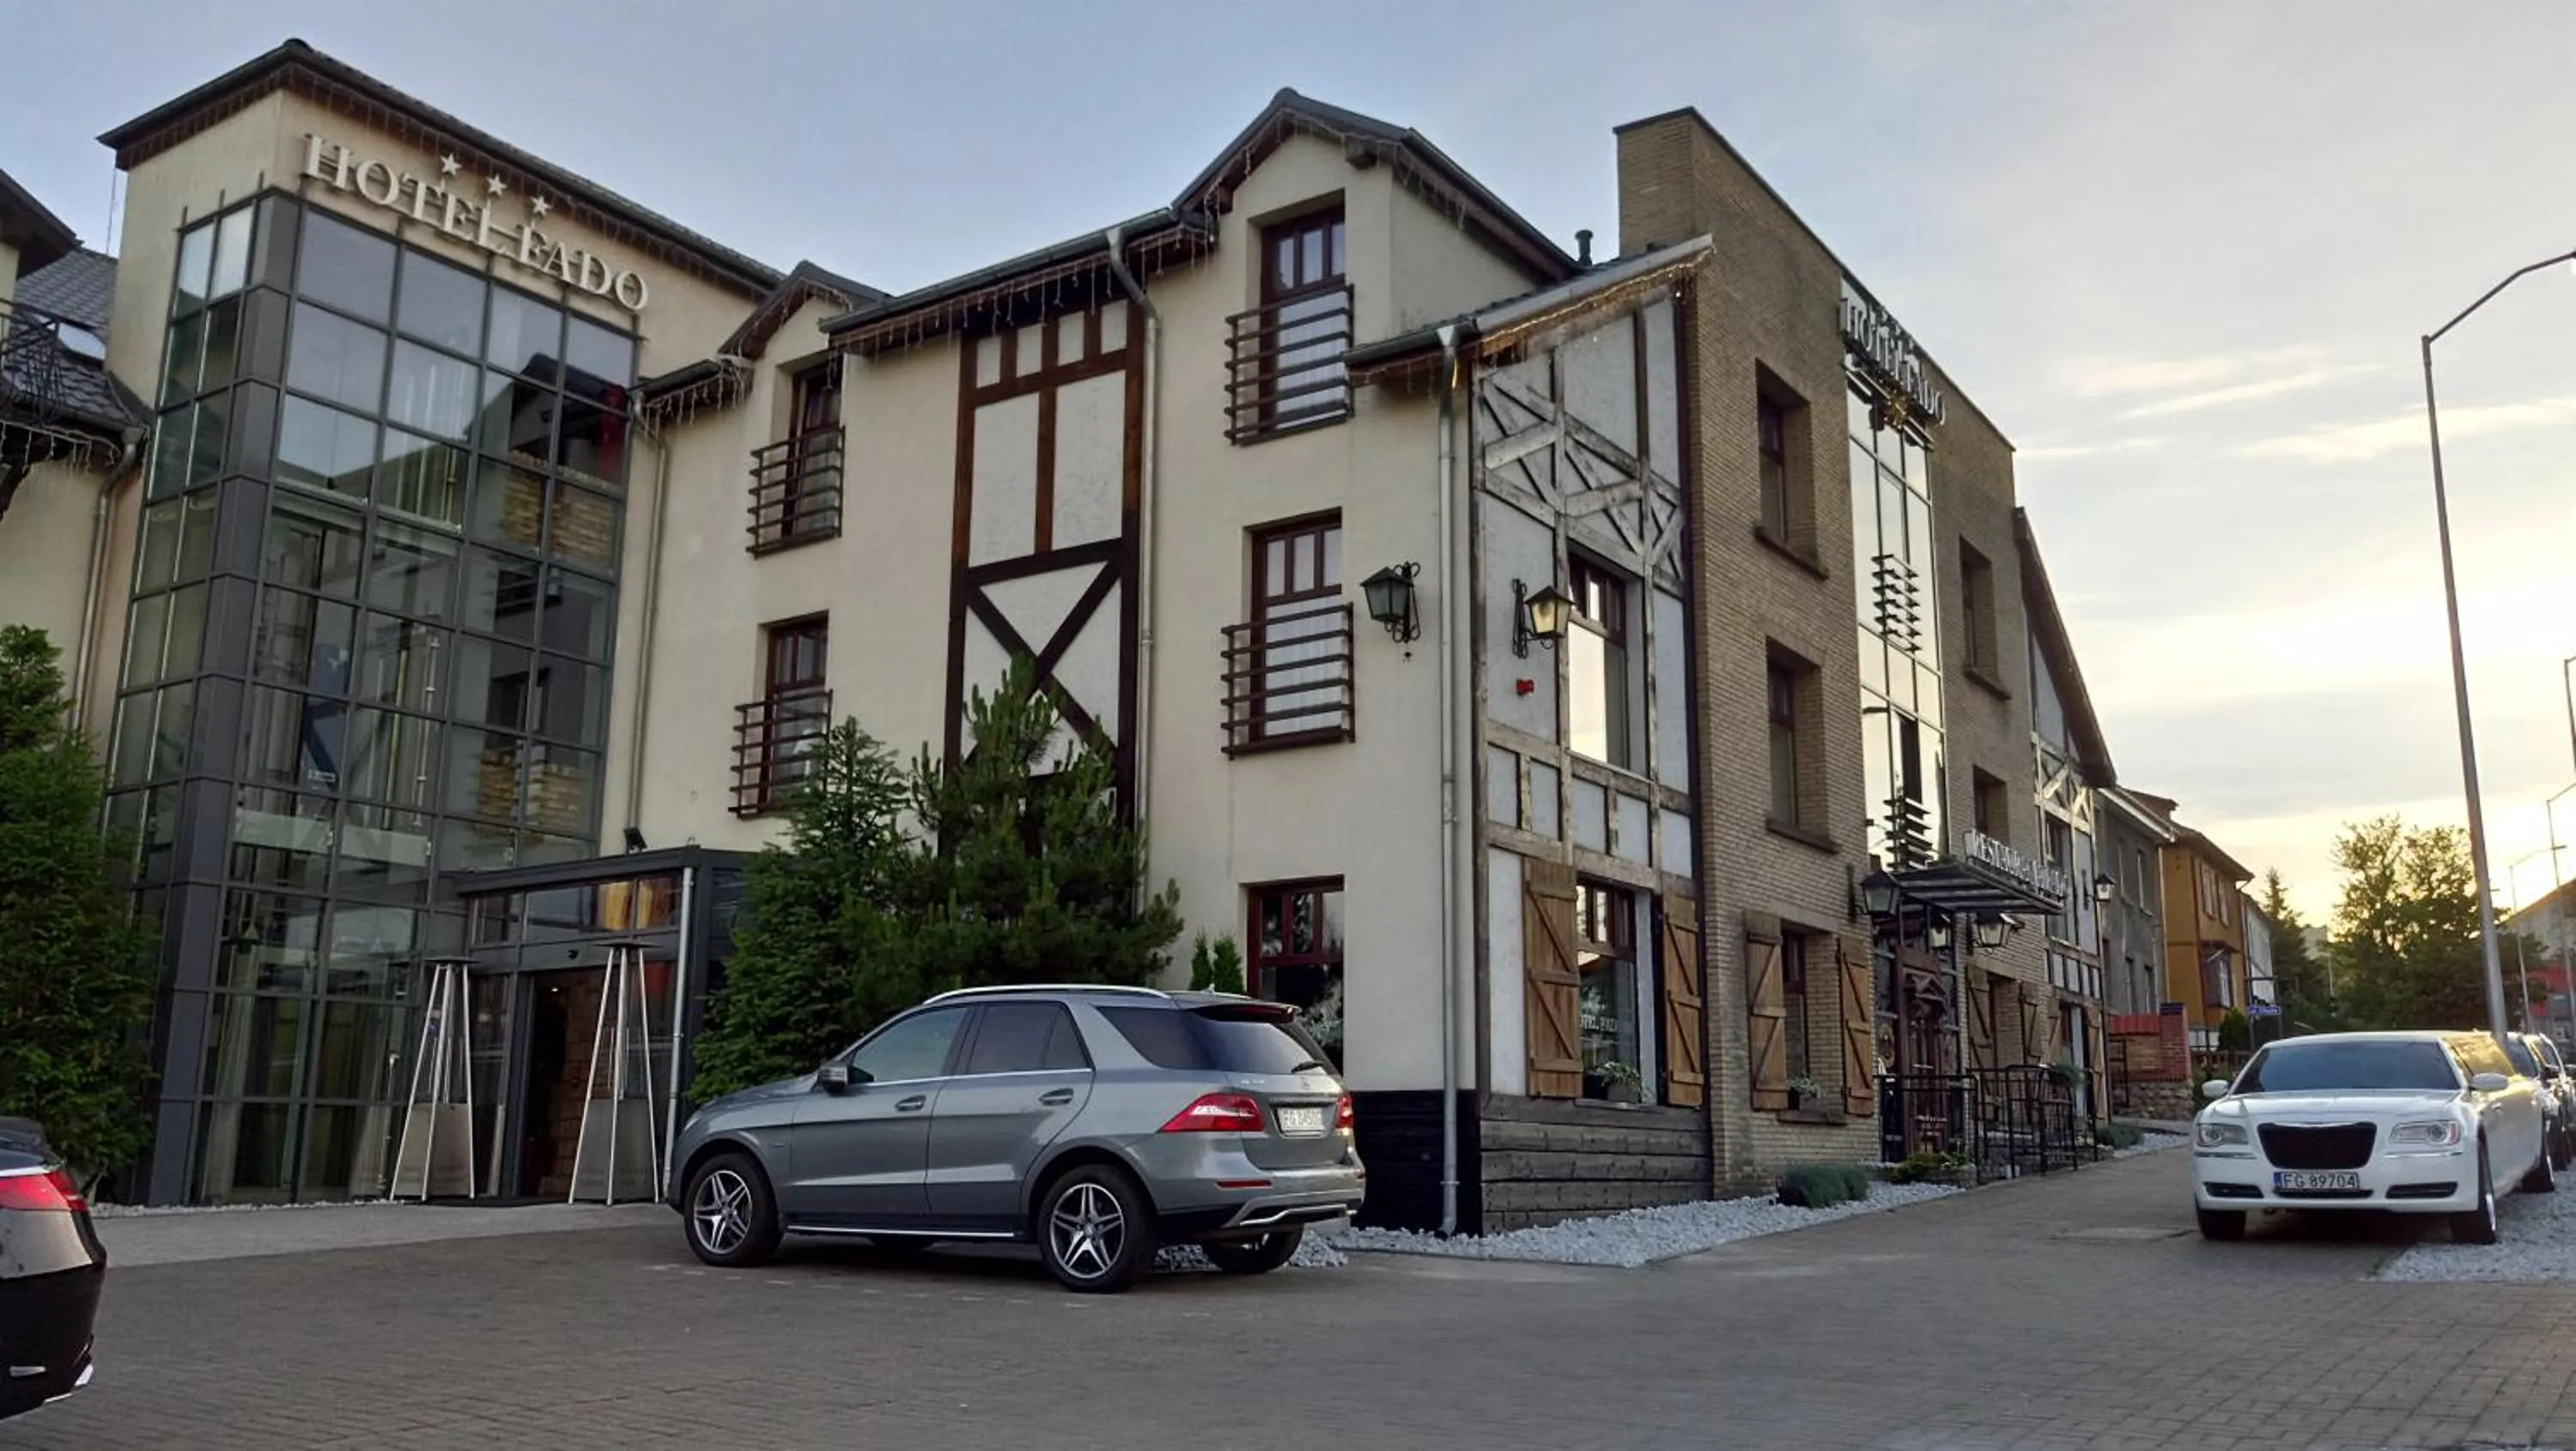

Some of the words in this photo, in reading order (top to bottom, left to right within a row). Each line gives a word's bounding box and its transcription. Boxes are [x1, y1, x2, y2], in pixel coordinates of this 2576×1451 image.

[303, 134, 516, 259] HOTEL
[518, 222, 650, 312] FADO
[2283, 1173, 2306, 1188] FG
[2309, 1173, 2356, 1189] 89704
